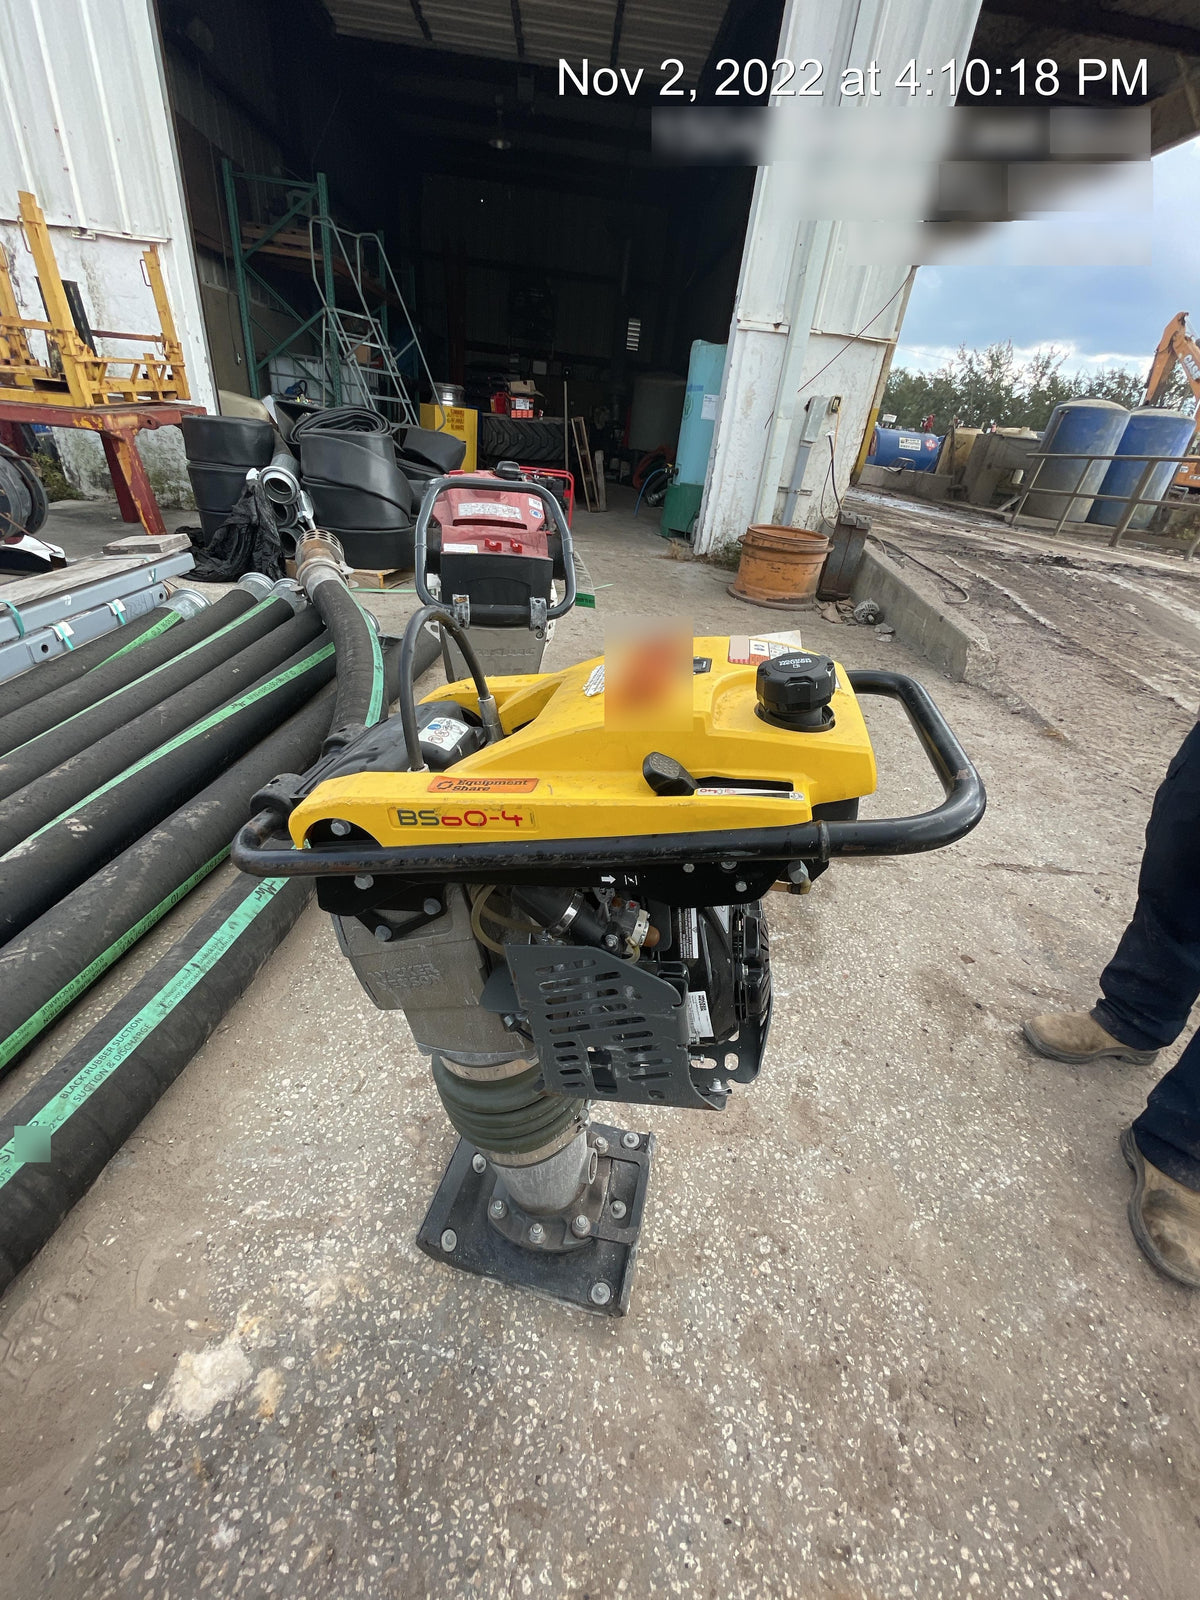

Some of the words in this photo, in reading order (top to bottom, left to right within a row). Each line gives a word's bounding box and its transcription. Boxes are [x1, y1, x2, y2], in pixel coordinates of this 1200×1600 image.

[457, 779, 528, 787] Equipment
[397, 809, 523, 827] BS60-4
[80, 956, 104, 979] SUCTION
[39, 982, 74, 1016] DISCHARGE
[41, 997, 70, 1024] SUCTION
[60, 1074, 87, 1099] BLACK
[85, 1047, 114, 1075] RUBBER
[112, 1017, 143, 1047] SUCTION
[73, 1068, 109, 1102] SUCTION
[107, 1060, 116, 1069] &
[114, 1024, 152, 1062] DISCHARGE
